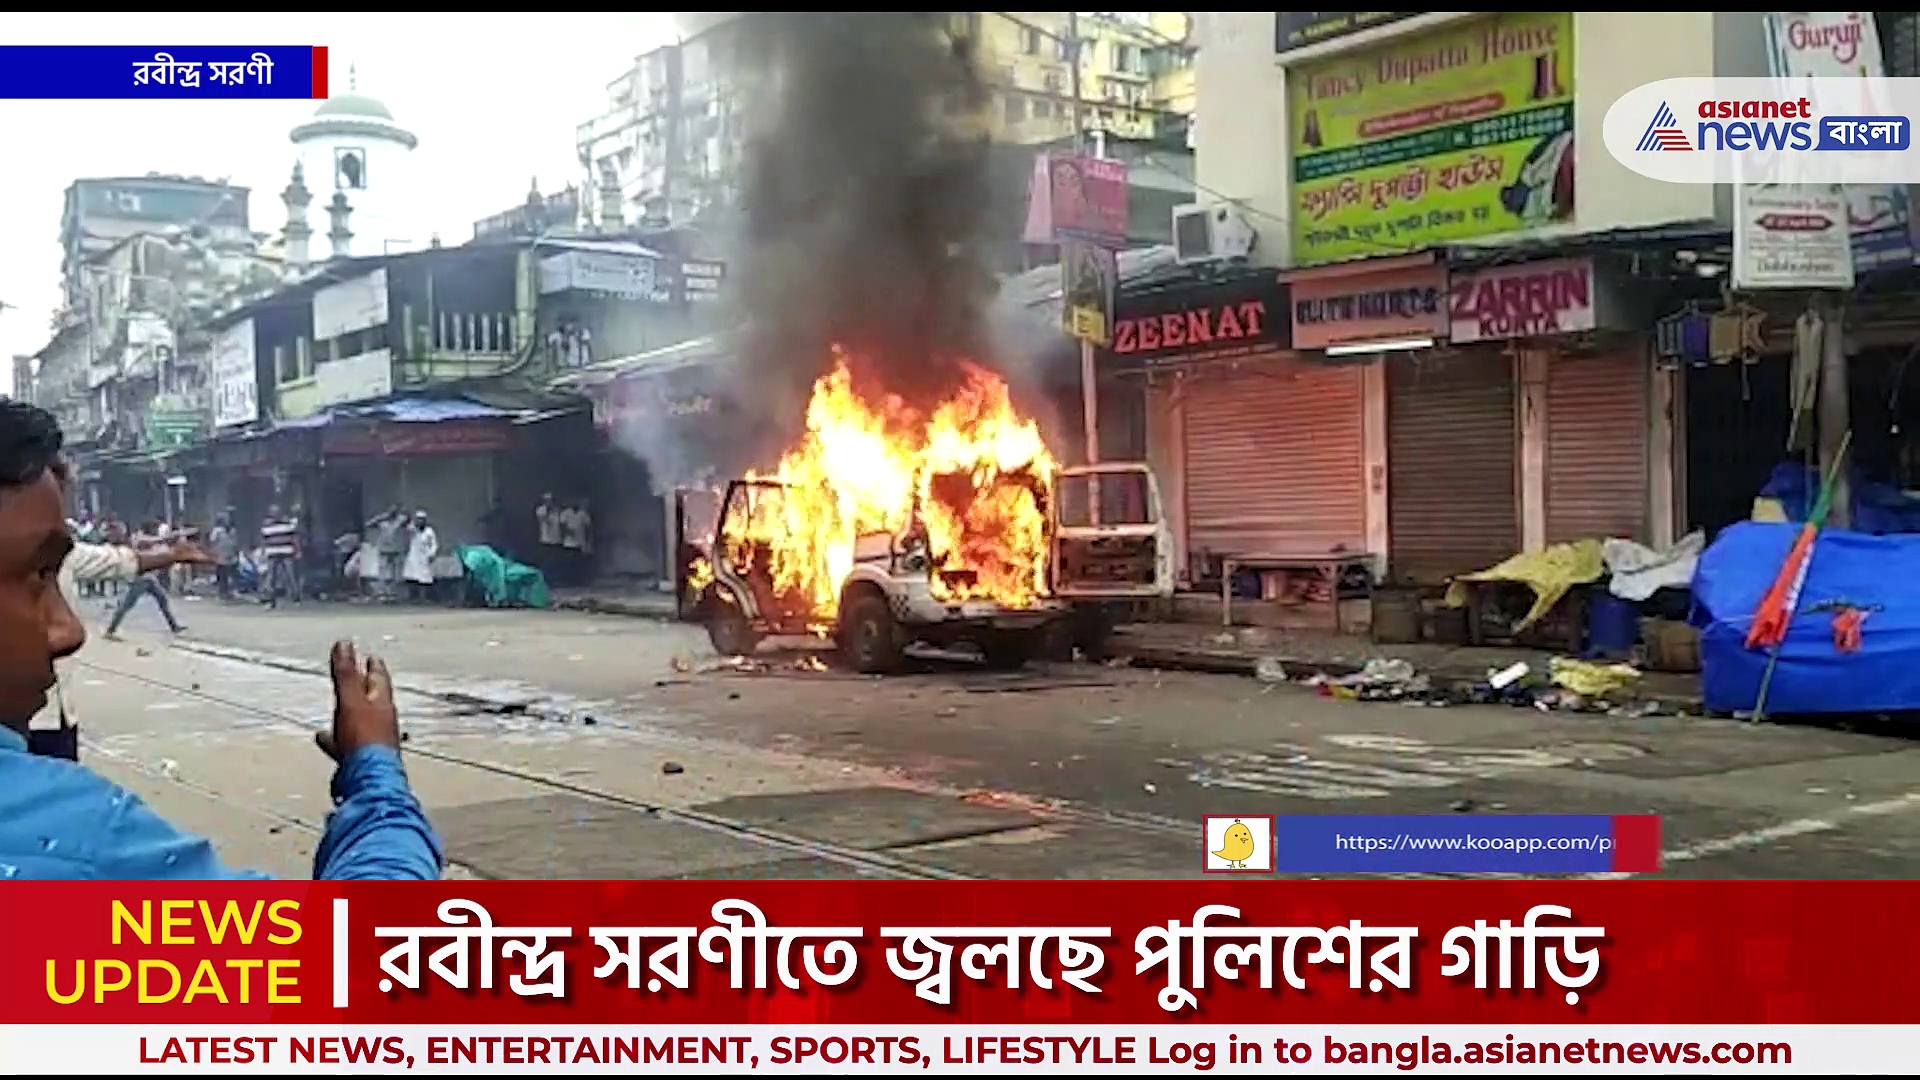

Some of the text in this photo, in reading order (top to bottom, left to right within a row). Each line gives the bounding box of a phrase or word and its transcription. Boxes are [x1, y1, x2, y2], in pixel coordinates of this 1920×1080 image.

[1482, 24, 1558, 63] House
[1788, 15, 1863, 63] Guruji
[1451, 267, 1589, 320] ZARRIN
[1114, 301, 1265, 354] ZEENAT
[1478, 310, 1560, 337] KURTA
